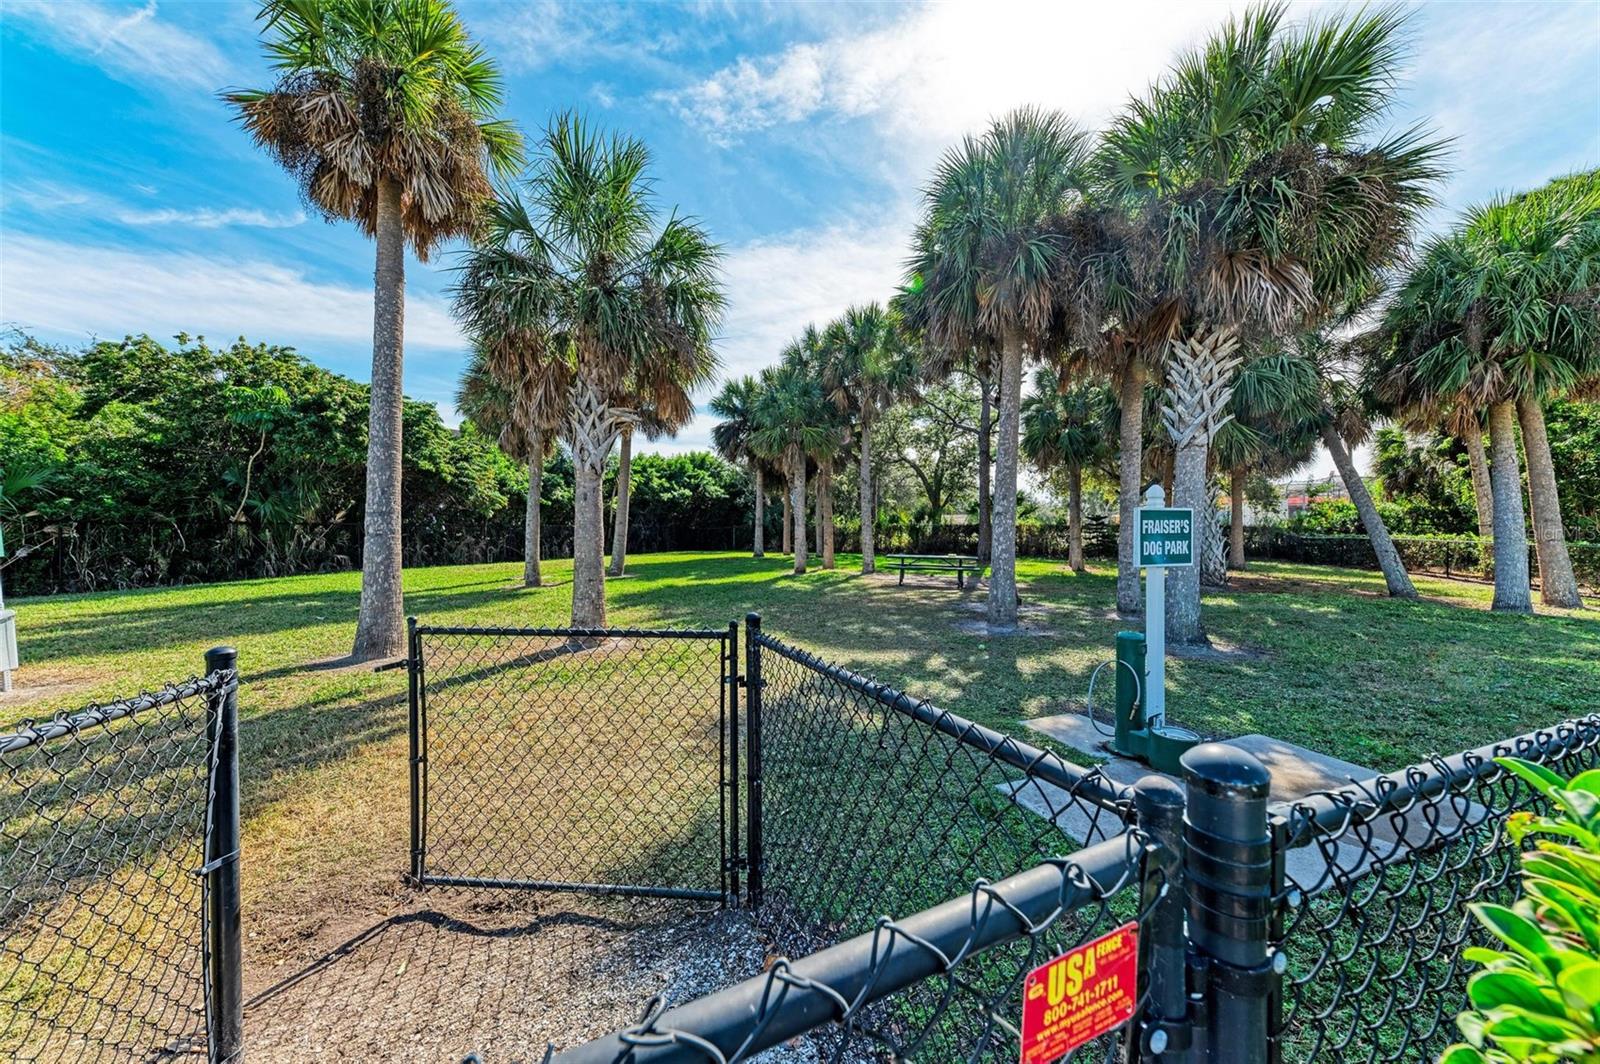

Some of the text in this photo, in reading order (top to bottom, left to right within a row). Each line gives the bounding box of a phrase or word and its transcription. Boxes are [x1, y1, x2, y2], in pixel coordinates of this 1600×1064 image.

[1142, 519, 1190, 534] FRAISER'S
[1143, 540, 1189, 556] DOG PARK
[1047, 947, 1096, 1006] USA
[1096, 934, 1123, 959] FENCE
